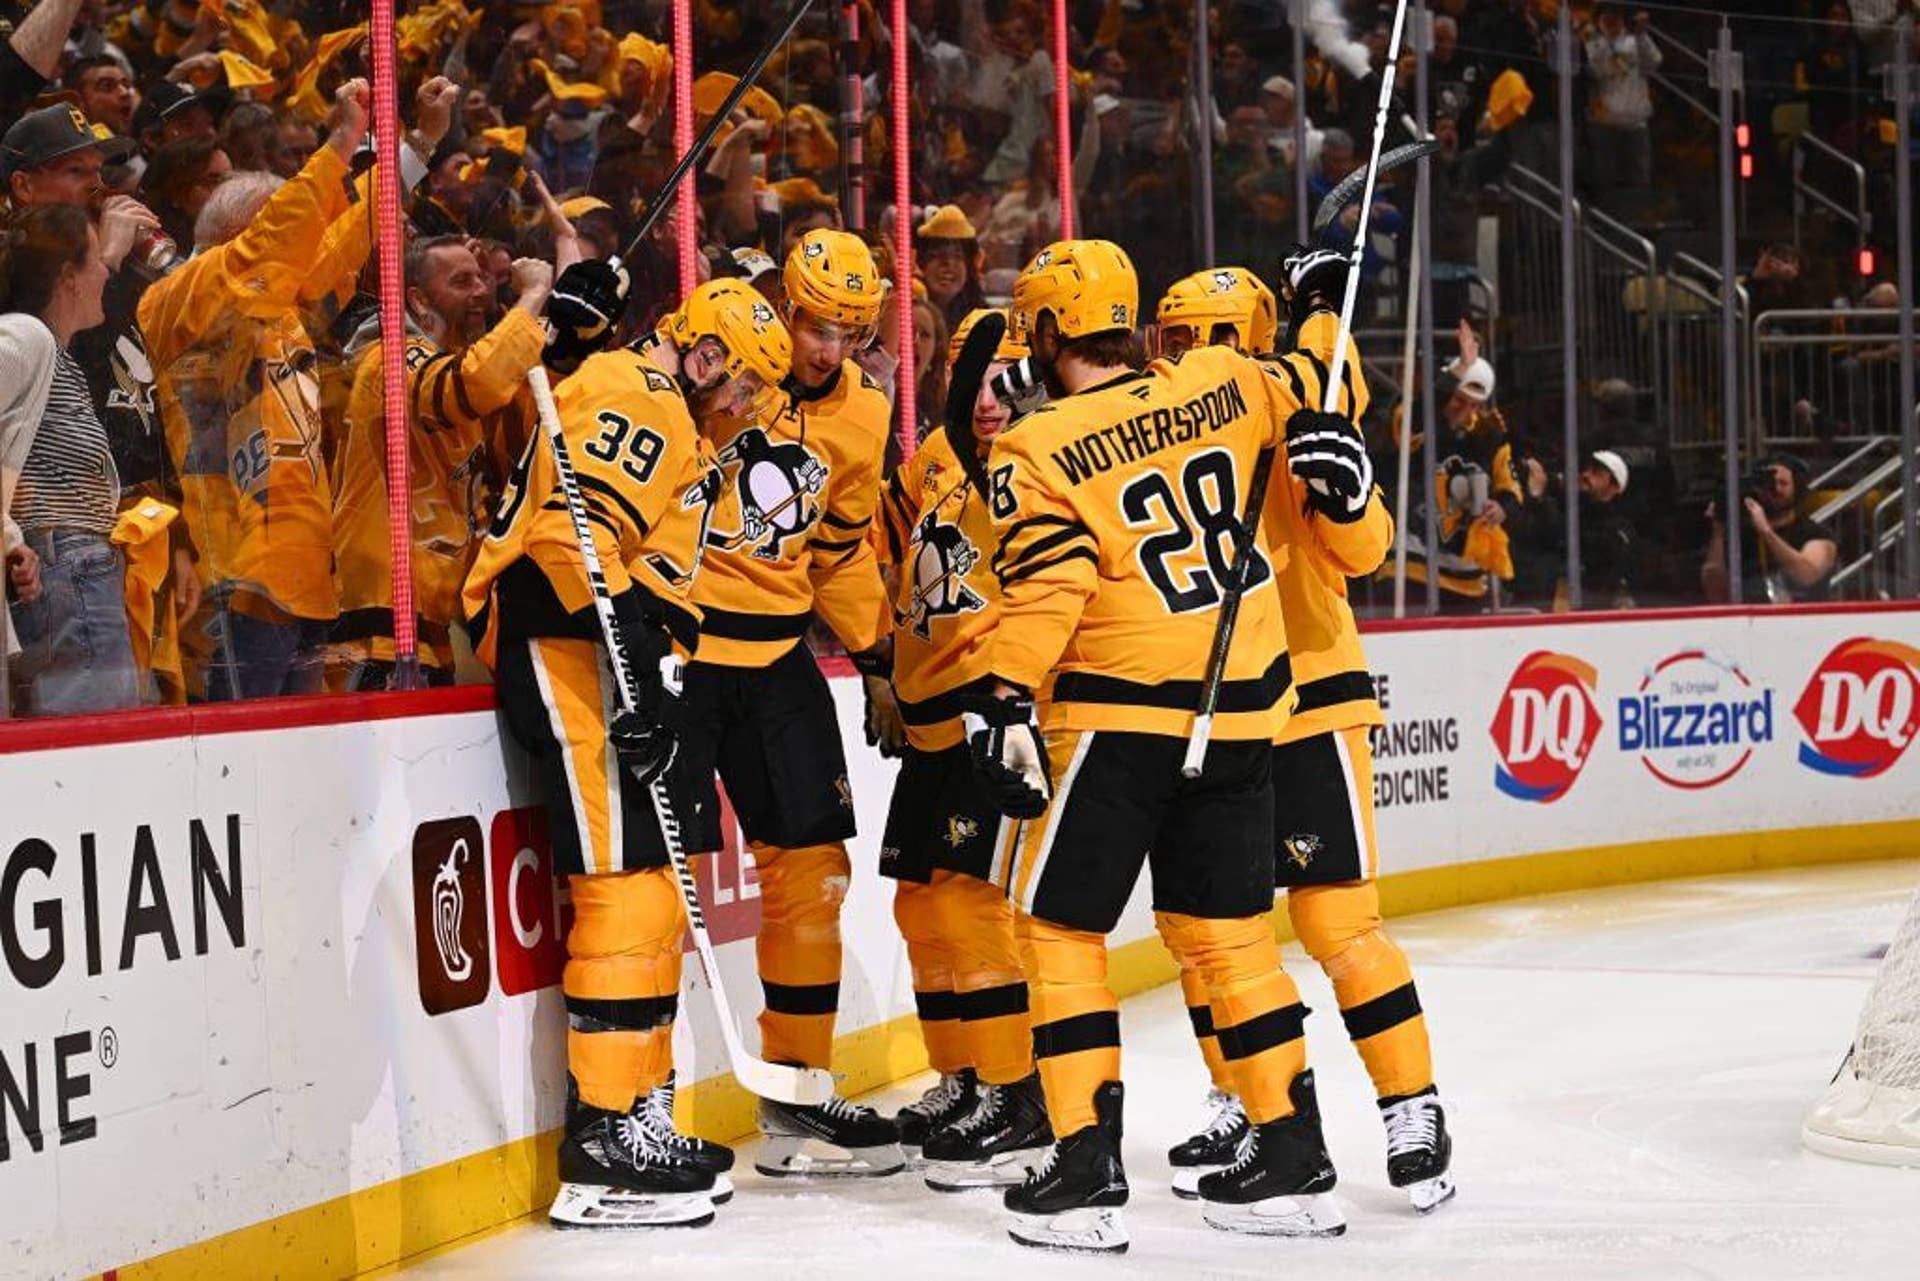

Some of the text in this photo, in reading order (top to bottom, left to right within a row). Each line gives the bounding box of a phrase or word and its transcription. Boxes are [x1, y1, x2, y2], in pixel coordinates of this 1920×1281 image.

[846, 273, 863, 291] 25
[1111, 303, 1128, 324] 28
[583, 409, 665, 484] 39
[1050, 377, 1248, 487] WOTHERSPOON
[1121, 448, 1271, 616] 28
[1507, 684, 1585, 771] DQ
[1618, 687, 1773, 751] Blizzard
[1814, 668, 1914, 748] DQ
[0, 813, 245, 989] GIAN
